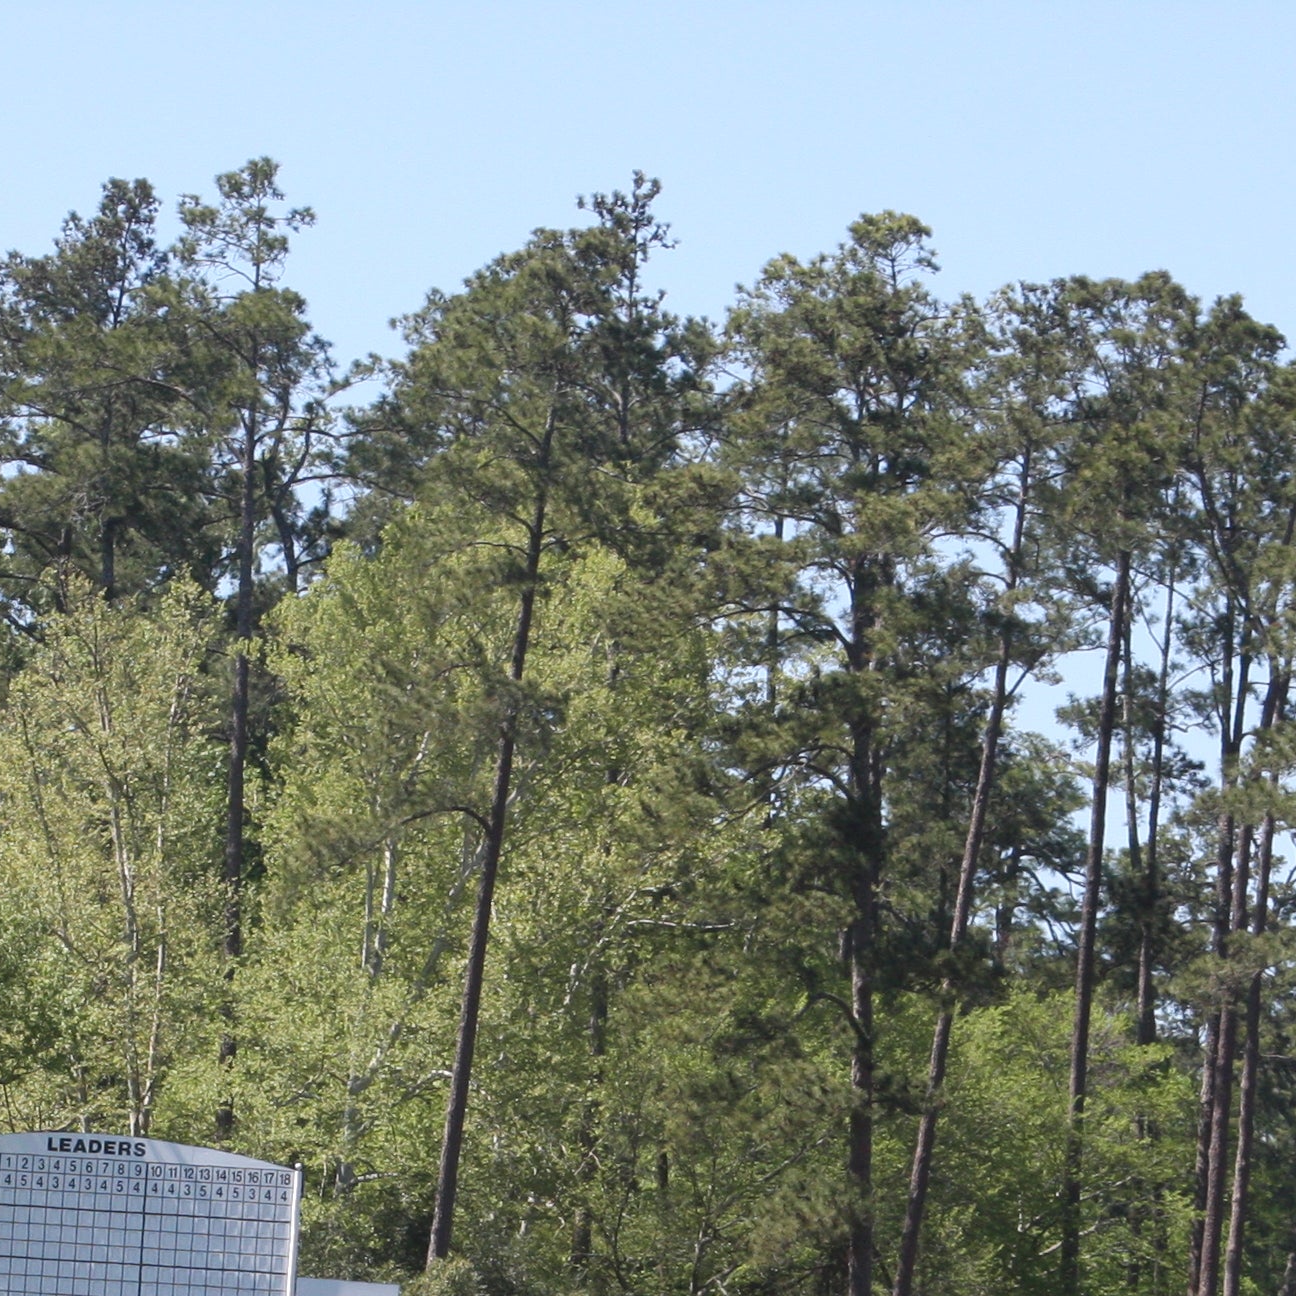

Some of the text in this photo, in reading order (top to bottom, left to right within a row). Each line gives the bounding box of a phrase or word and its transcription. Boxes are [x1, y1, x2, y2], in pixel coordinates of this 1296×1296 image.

[47, 1137, 146, 1157] LEADERS
[7, 1157, 11, 1167] 1
[22, 1158, 28, 1169] 2
[38, 1159, 44, 1170] 3
[53, 1160, 60, 1171] 4
[70, 1161, 76, 1172] 5
[86, 1162, 93, 1173] 6
[102, 1163, 109, 1173] 7
[118, 1164, 125, 1175] 8
[135, 1165, 142, 1176] 9
[151, 1166, 162, 1178] 10
[168, 1167, 177, 1178] 11
[184, 1168, 194, 1179] 12
[199, 1169, 210, 1180] 13
[215, 1170, 226, 1181] 14
[232, 1171, 242, 1182] 15
[248, 1172, 259, 1183] 16
[264, 1173, 275, 1184] 17
[280, 1174, 291, 1185] 18
[4, 1174, 11, 1185] 4
[21, 1175, 27, 1186] 5
[36, 1177, 43, 1187] 4
[52, 1177, 59, 1188] 3
[68, 1178, 75, 1188] 4
[84, 1179, 91, 1190] 3
[100, 1180, 107, 1190] 4
[116, 1181, 123, 1192] 5
[133, 1182, 140, 1192] 4
[152, 1183, 159, 1194] 4
[168, 1184, 175, 1194] 4
[184, 1184, 191, 1195] 3
[200, 1185, 207, 1197] 5
[216, 1187, 223, 1197] 4
[232, 1187, 239, 1198] 5
[249, 1188, 256, 1199] 3
[264, 1190, 272, 1200] 4
[280, 1191, 287, 1201] 4
